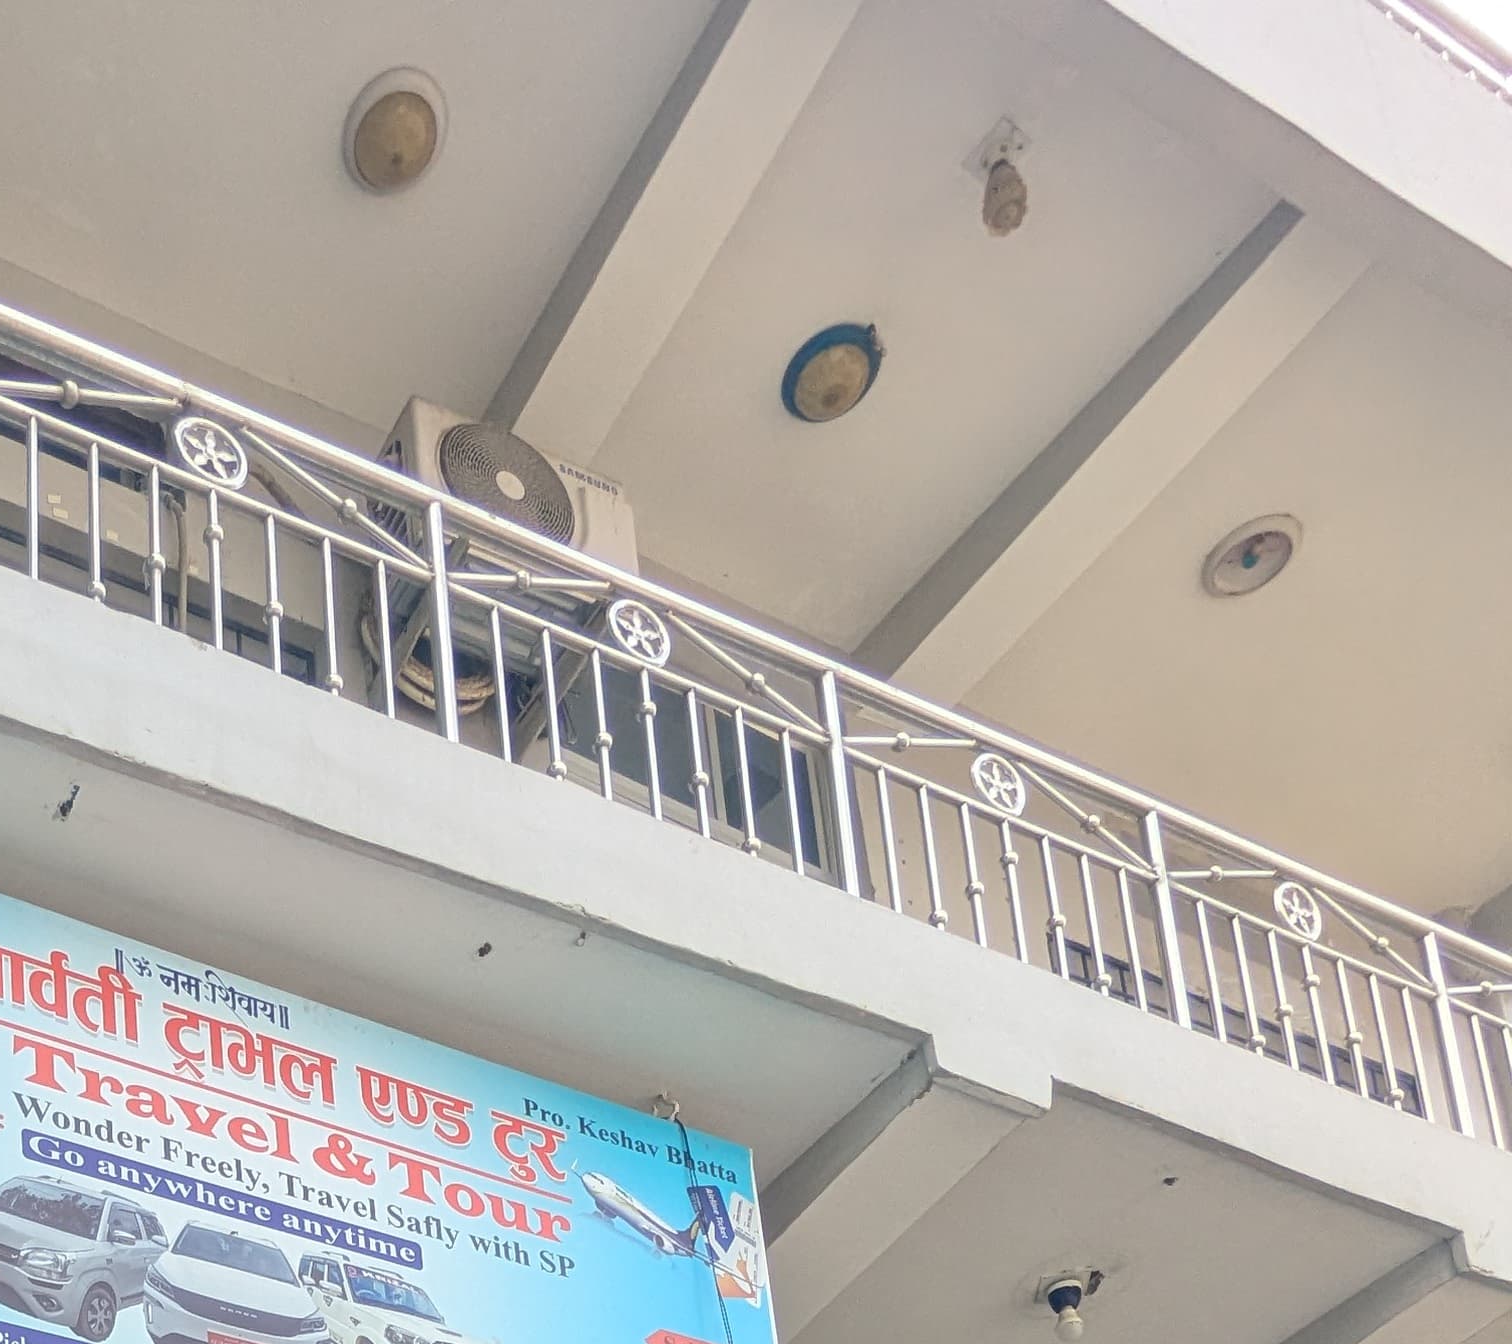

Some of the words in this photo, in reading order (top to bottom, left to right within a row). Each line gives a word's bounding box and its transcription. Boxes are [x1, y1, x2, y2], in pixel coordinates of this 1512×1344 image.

[559, 463, 618, 496] SAMSUNG
[162, 1002, 337, 1105] ट्राभल
[355, 1065, 473, 1144] एण्ड
[491, 1110, 567, 1183] टुर
[522, 1098, 571, 1130] Pro.
[577, 1115, 659, 1158] Keshav
[667, 1143, 738, 1184] Bhatta
[13, 1091, 150, 1153] Wonder
[160, 1136, 270, 1195] Freely,
[278, 1171, 376, 1221] Travel
[387, 1205, 459, 1249] Safly
[469, 1233, 530, 1267] with
[539, 1249, 576, 1279] SP
[28, 1135, 85, 1167] Go
[97, 1157, 272, 1222] anywhere
[283, 1210, 417, 1263] anytime
[312, 1133, 376, 1186] &
[388, 1151, 571, 1243] Tour
